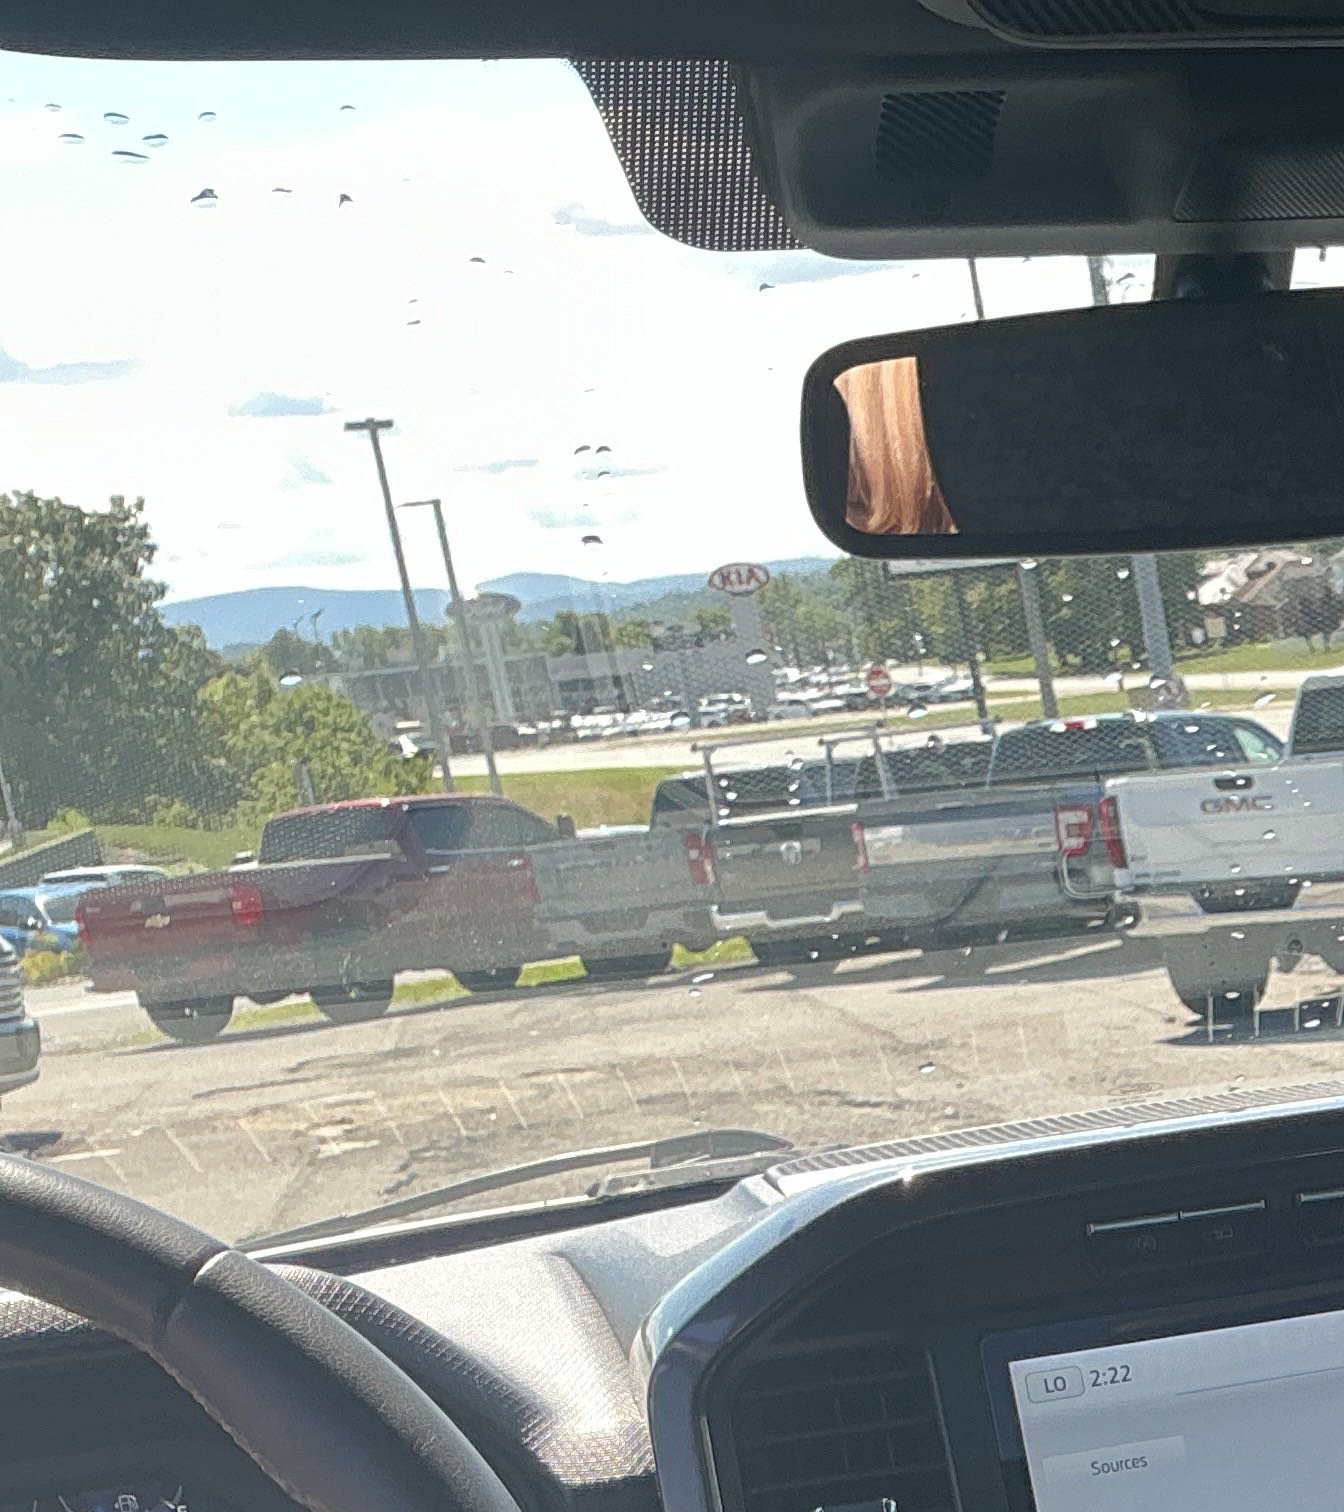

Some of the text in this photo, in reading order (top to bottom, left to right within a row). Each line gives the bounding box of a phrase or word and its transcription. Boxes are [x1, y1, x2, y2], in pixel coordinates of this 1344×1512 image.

[1200, 795, 1276, 812] GMC
[1043, 1364, 1132, 1394] LO 2:22
[1090, 1455, 1148, 1477] Sources
